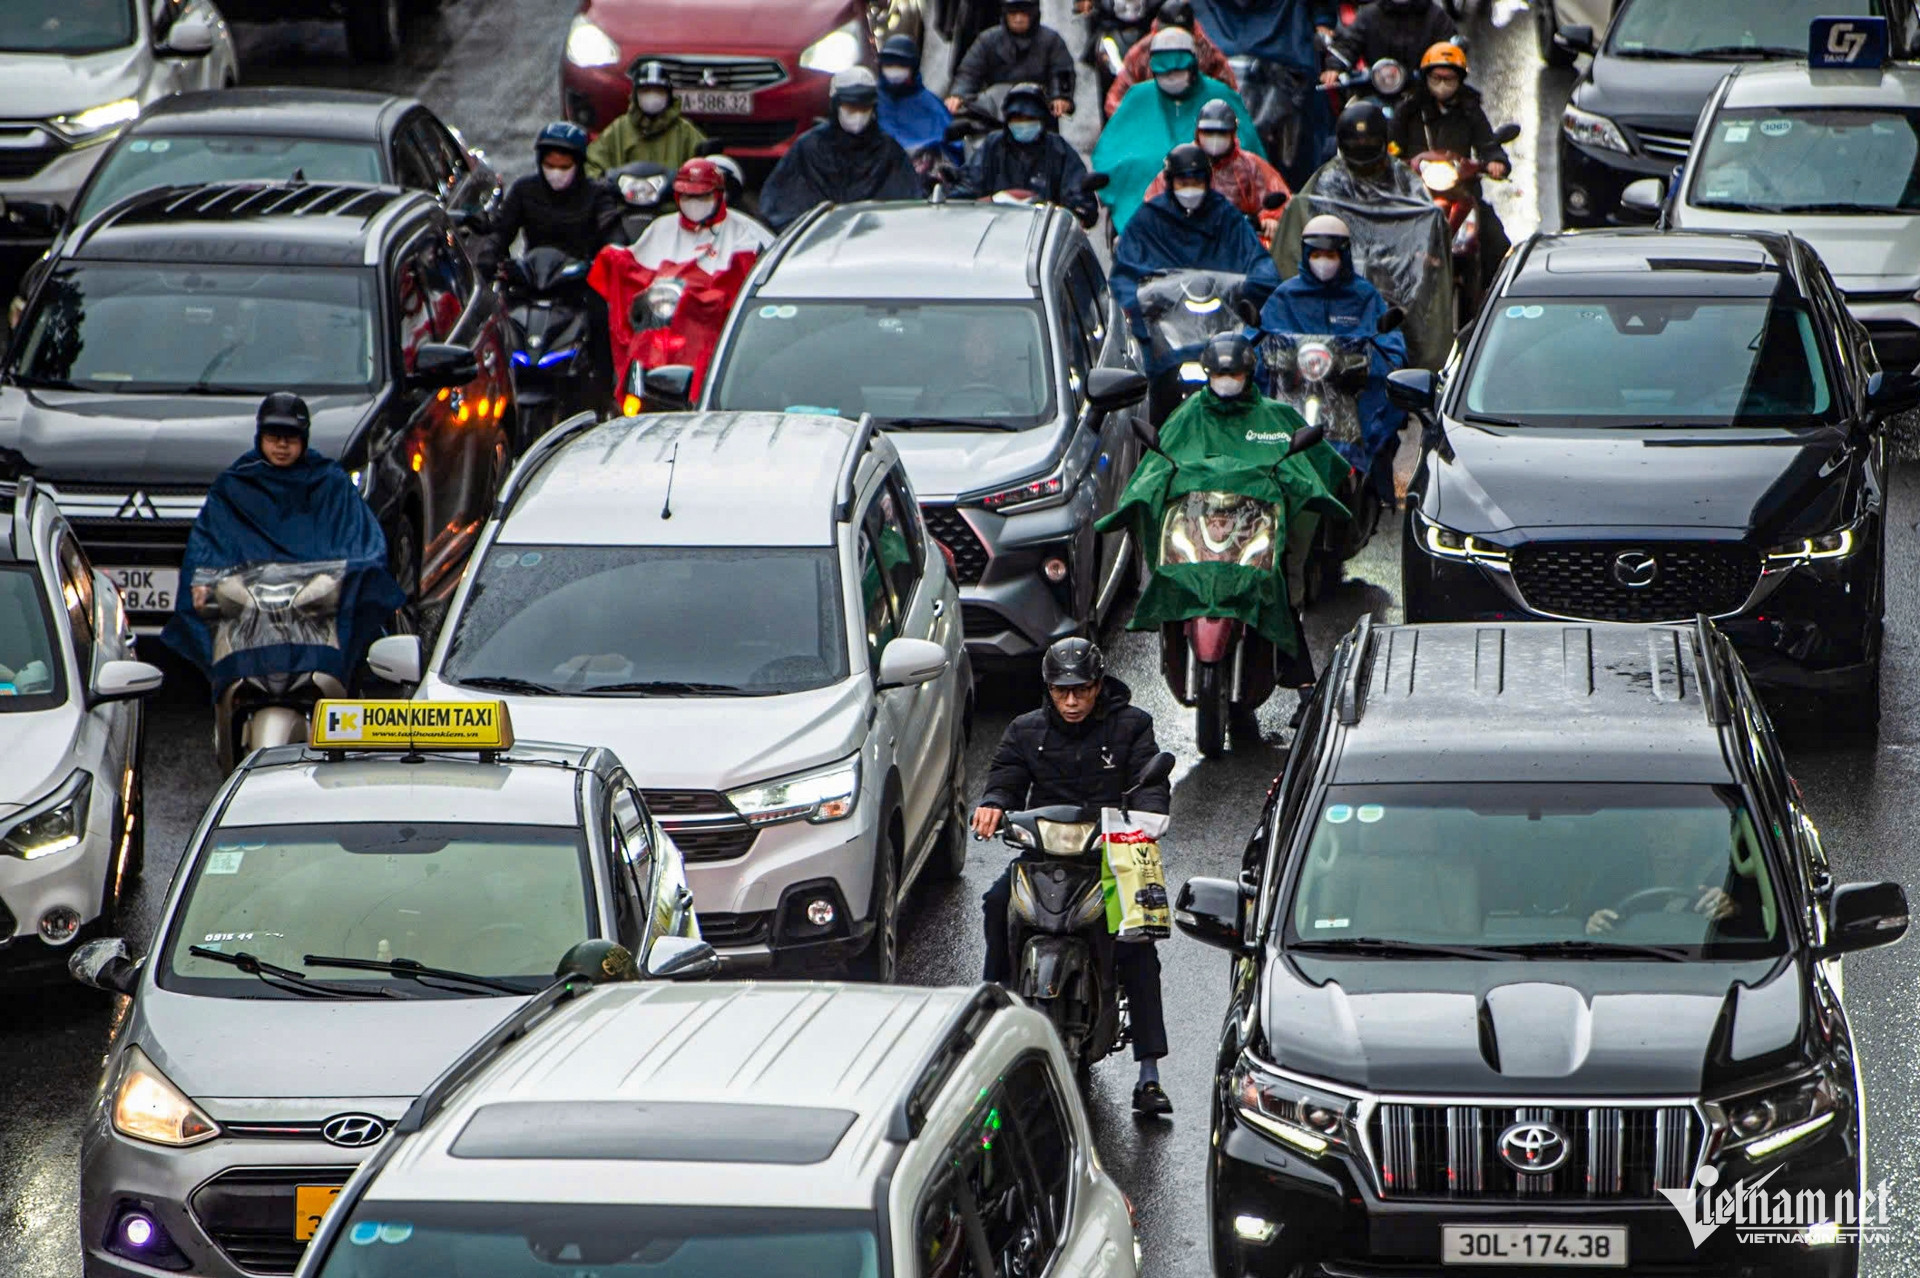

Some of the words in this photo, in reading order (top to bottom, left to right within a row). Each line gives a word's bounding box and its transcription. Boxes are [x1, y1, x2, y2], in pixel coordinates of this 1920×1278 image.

[1827, 23, 1867, 62] G7
[677, 93, 747, 111] A-586.32
[118, 571, 153, 589] 30K
[122, 590, 170, 609] 8.46
[363, 708, 408, 726] HOAN
[411, 708, 450, 726] KIEM
[453, 708, 492, 726] TAXI
[371, 730, 479, 738] www.taxihoankiem.vn
[1459, 1233, 1610, 1258] 30L-174.38
